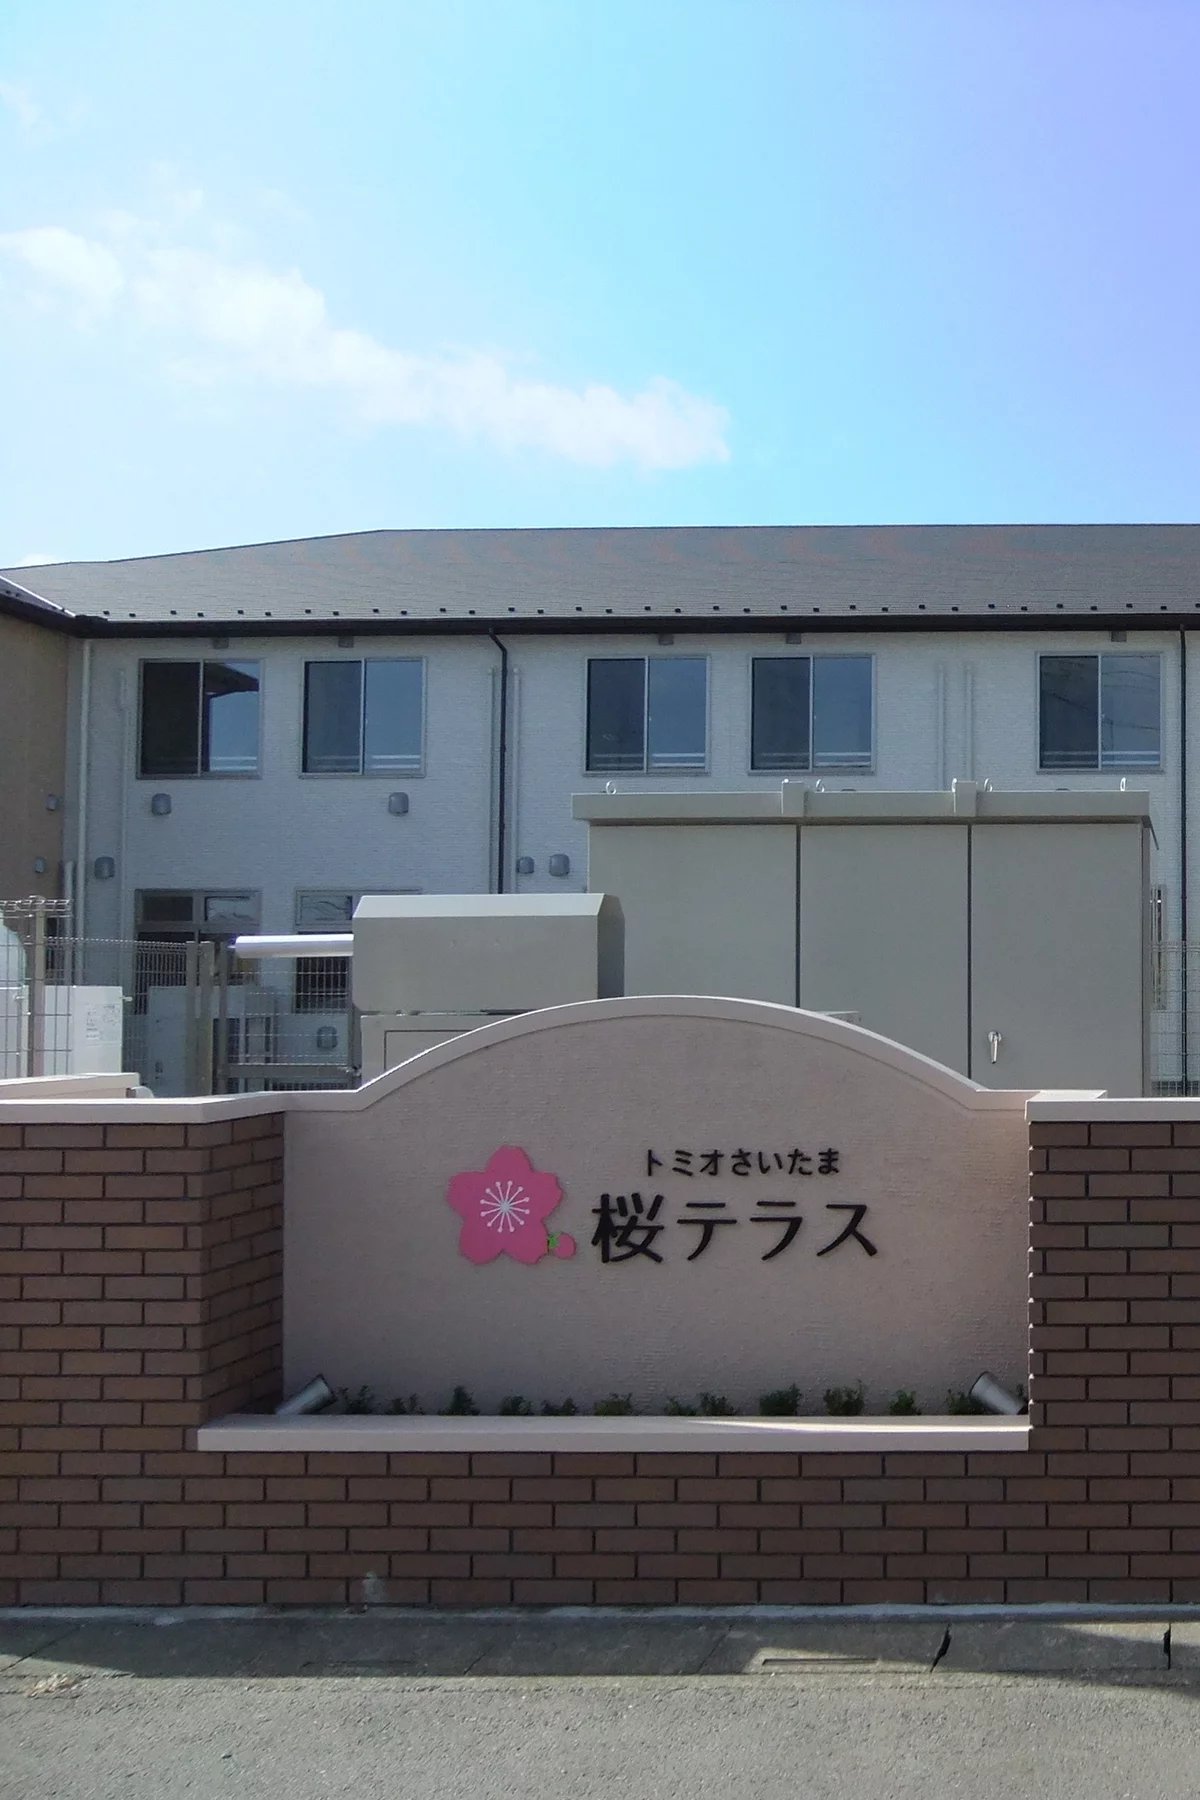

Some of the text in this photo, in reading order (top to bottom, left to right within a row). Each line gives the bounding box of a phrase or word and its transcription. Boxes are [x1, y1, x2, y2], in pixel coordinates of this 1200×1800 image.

[645, 1147, 841, 1177] トミオさいたま
[591, 1192, 878, 1263] 桜テラス
